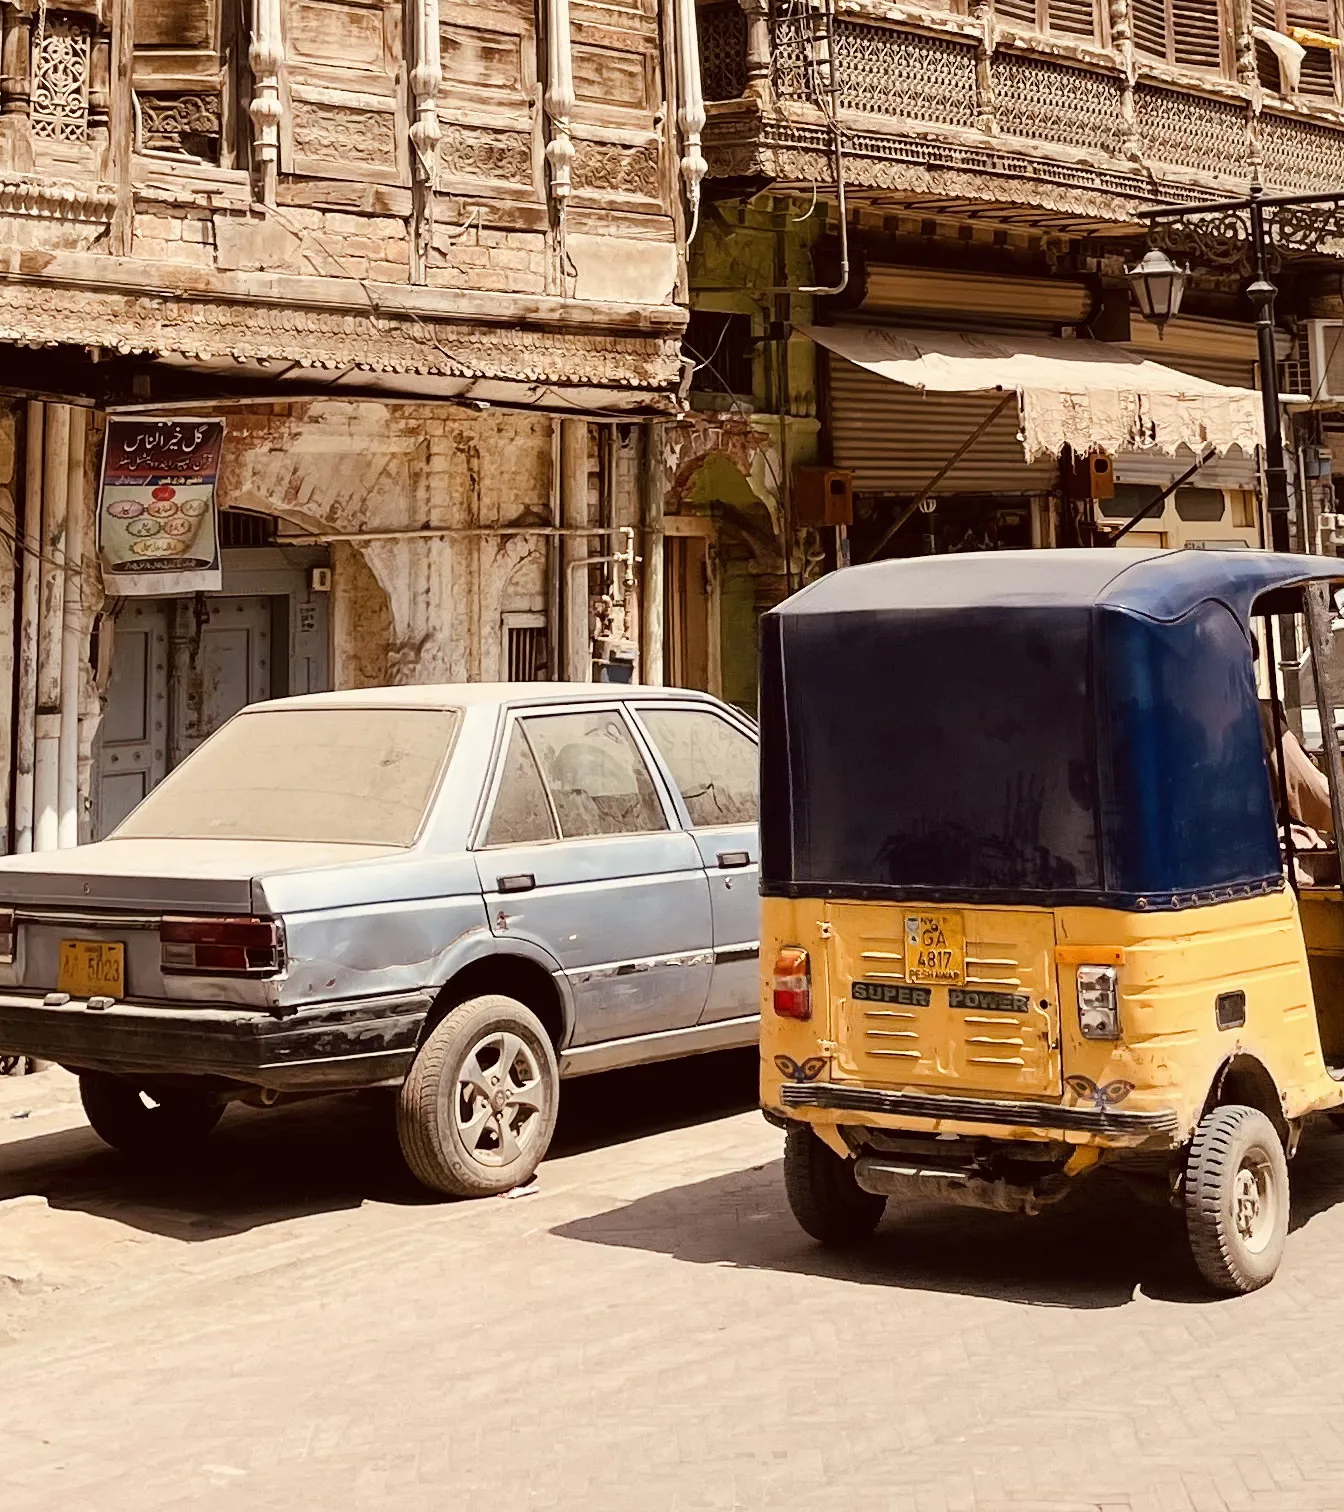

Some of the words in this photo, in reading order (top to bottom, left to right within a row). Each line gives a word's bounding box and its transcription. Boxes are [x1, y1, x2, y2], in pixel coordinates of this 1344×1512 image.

[182, 424, 208, 452] گل
[922, 929, 947, 947] GA
[88, 957, 120, 982] 5023
[918, 950, 952, 968] 4817
[909, 969, 960, 979] PESHAWAR
[854, 984, 931, 1006] SUPER
[948, 991, 1029, 1012] POWER
